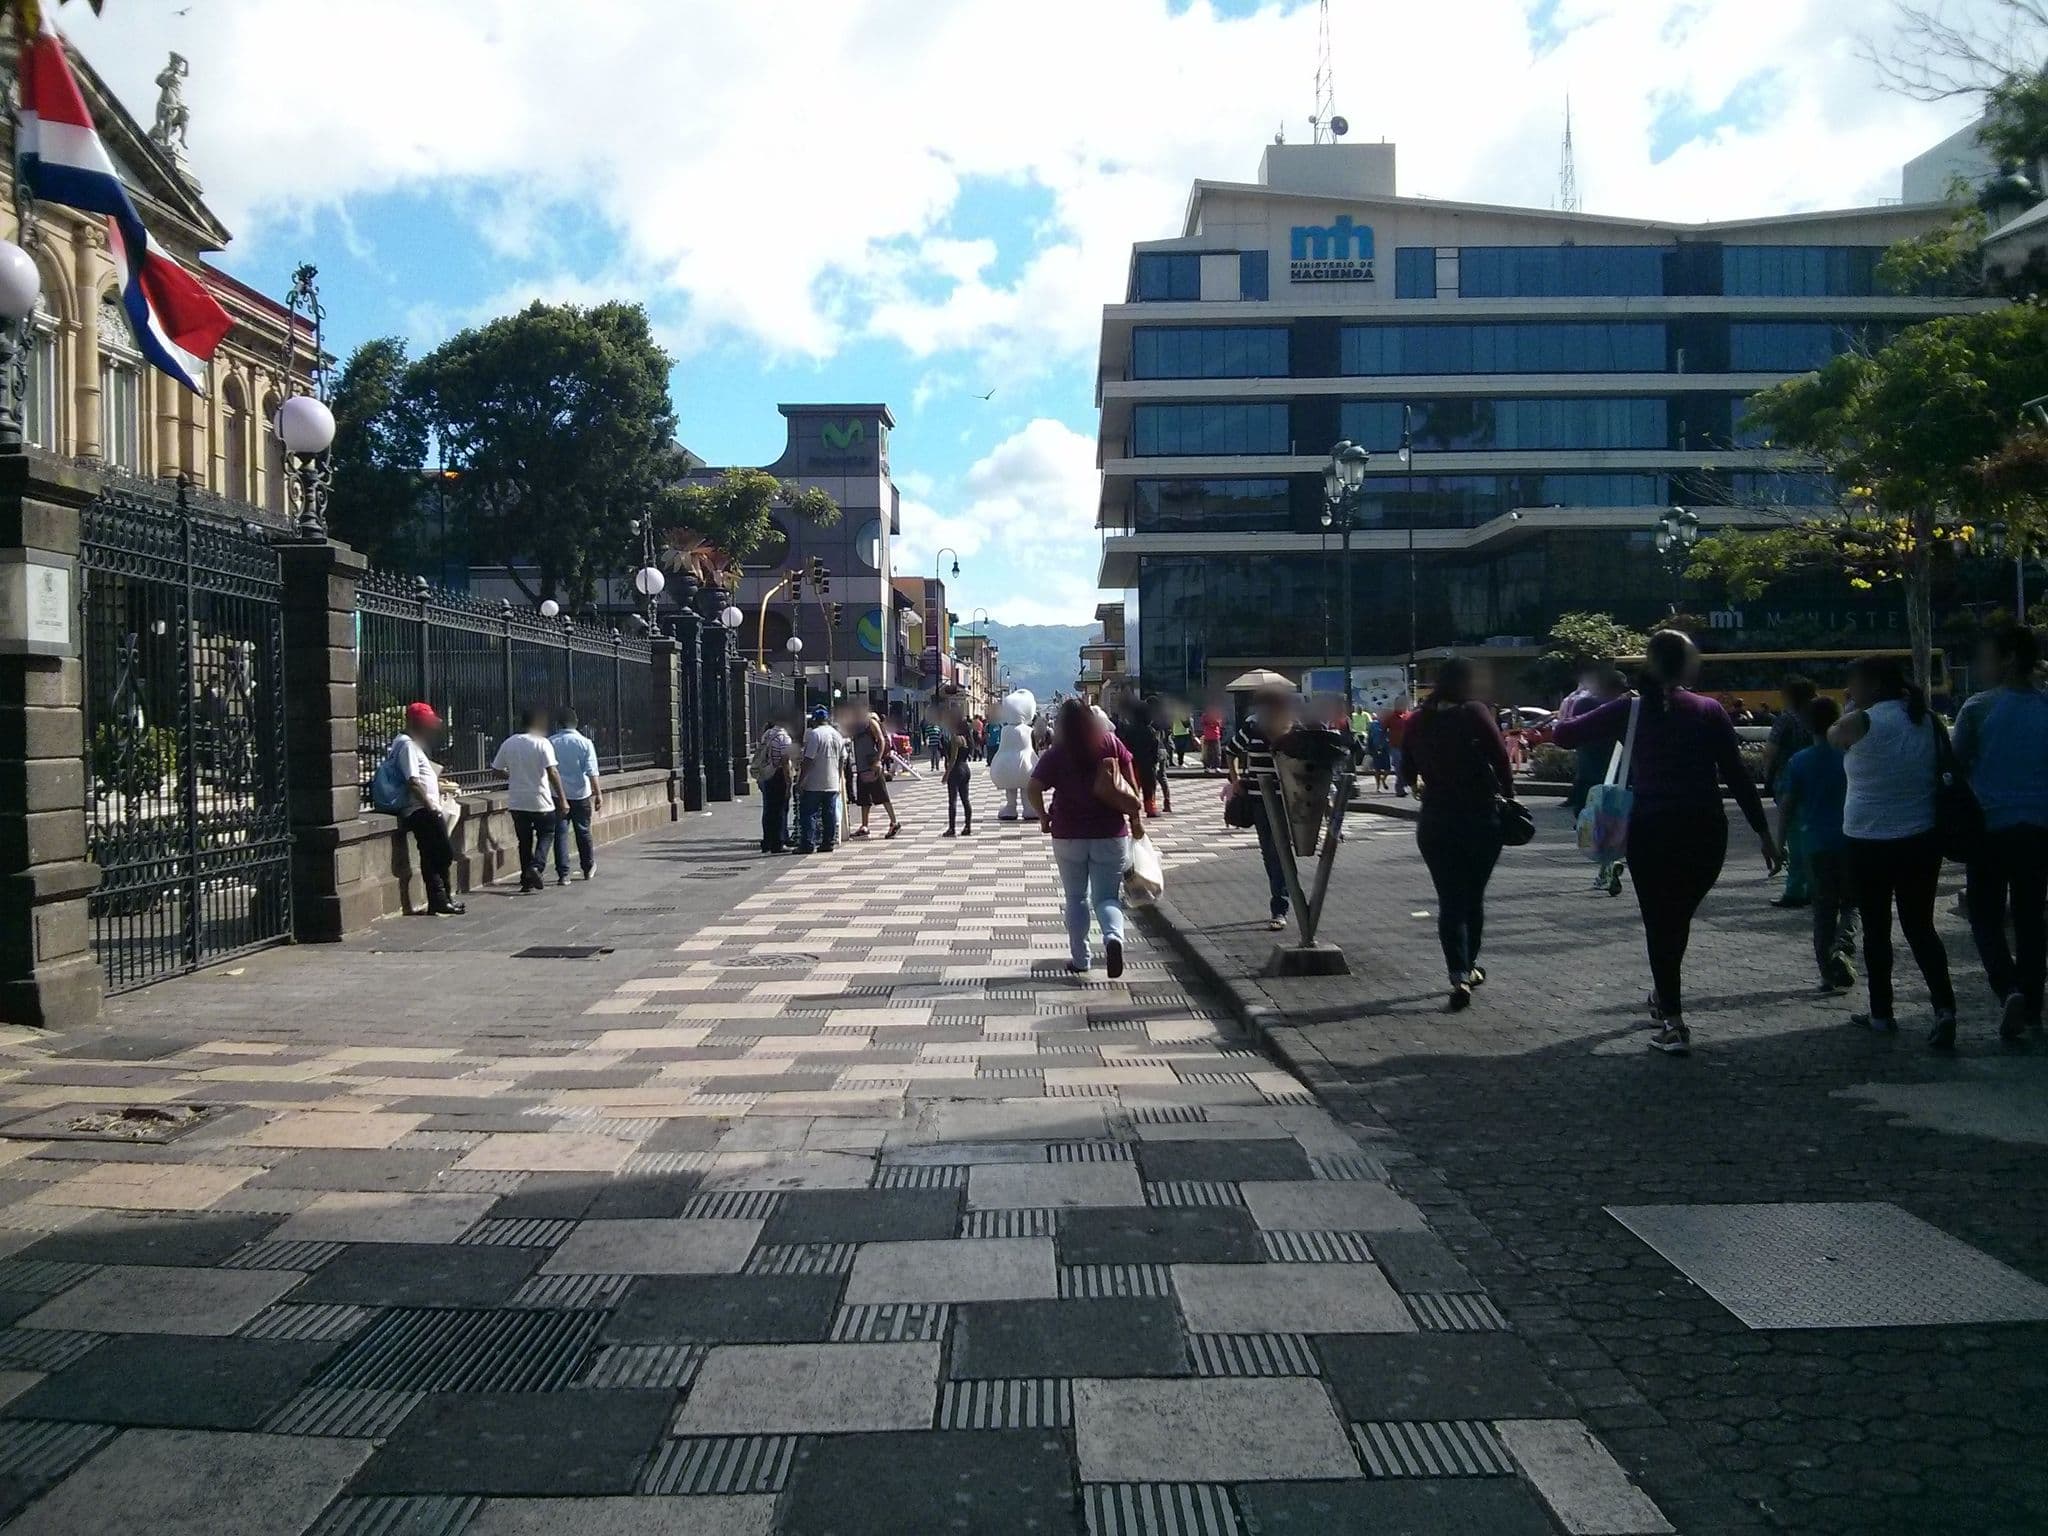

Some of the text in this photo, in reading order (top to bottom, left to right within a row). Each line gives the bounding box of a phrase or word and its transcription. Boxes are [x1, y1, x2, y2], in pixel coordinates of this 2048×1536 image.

[1291, 261, 1374, 269] MINISTERIO DE
[1291, 269, 1374, 279] HACIENDA
